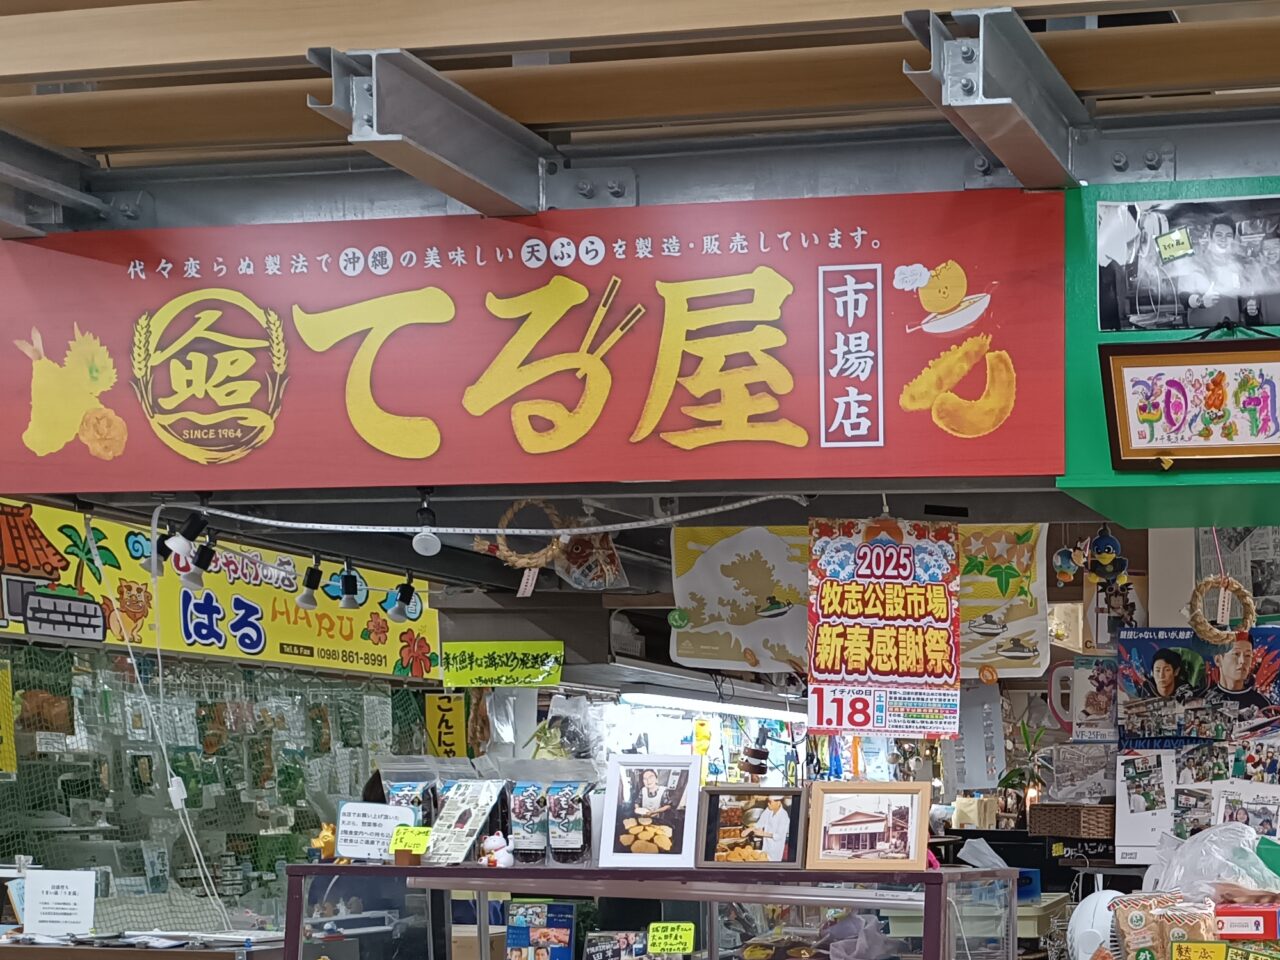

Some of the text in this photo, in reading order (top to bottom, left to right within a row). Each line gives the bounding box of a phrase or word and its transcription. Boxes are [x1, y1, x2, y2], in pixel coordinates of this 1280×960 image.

[292, 265, 809, 459] てる屋
[826, 273, 876, 438] 市場店
[182, 428, 244, 441] SINCE 1964
[856, 545, 913, 578] 2025
[180, 588, 264, 652] はる
[271, 596, 354, 641] HARU
[821, 580, 950, 620] 牧志公設市場
[316, 649, 388, 667] (098) 861-8991
[814, 623, 953, 674] 新春感謝祭
[811, 687, 872, 728] 1.18
[830, 688, 872, 697] イチバの日
[875, 693, 885, 724] 土曜日
[1121, 738, 1153, 749] YUKI
